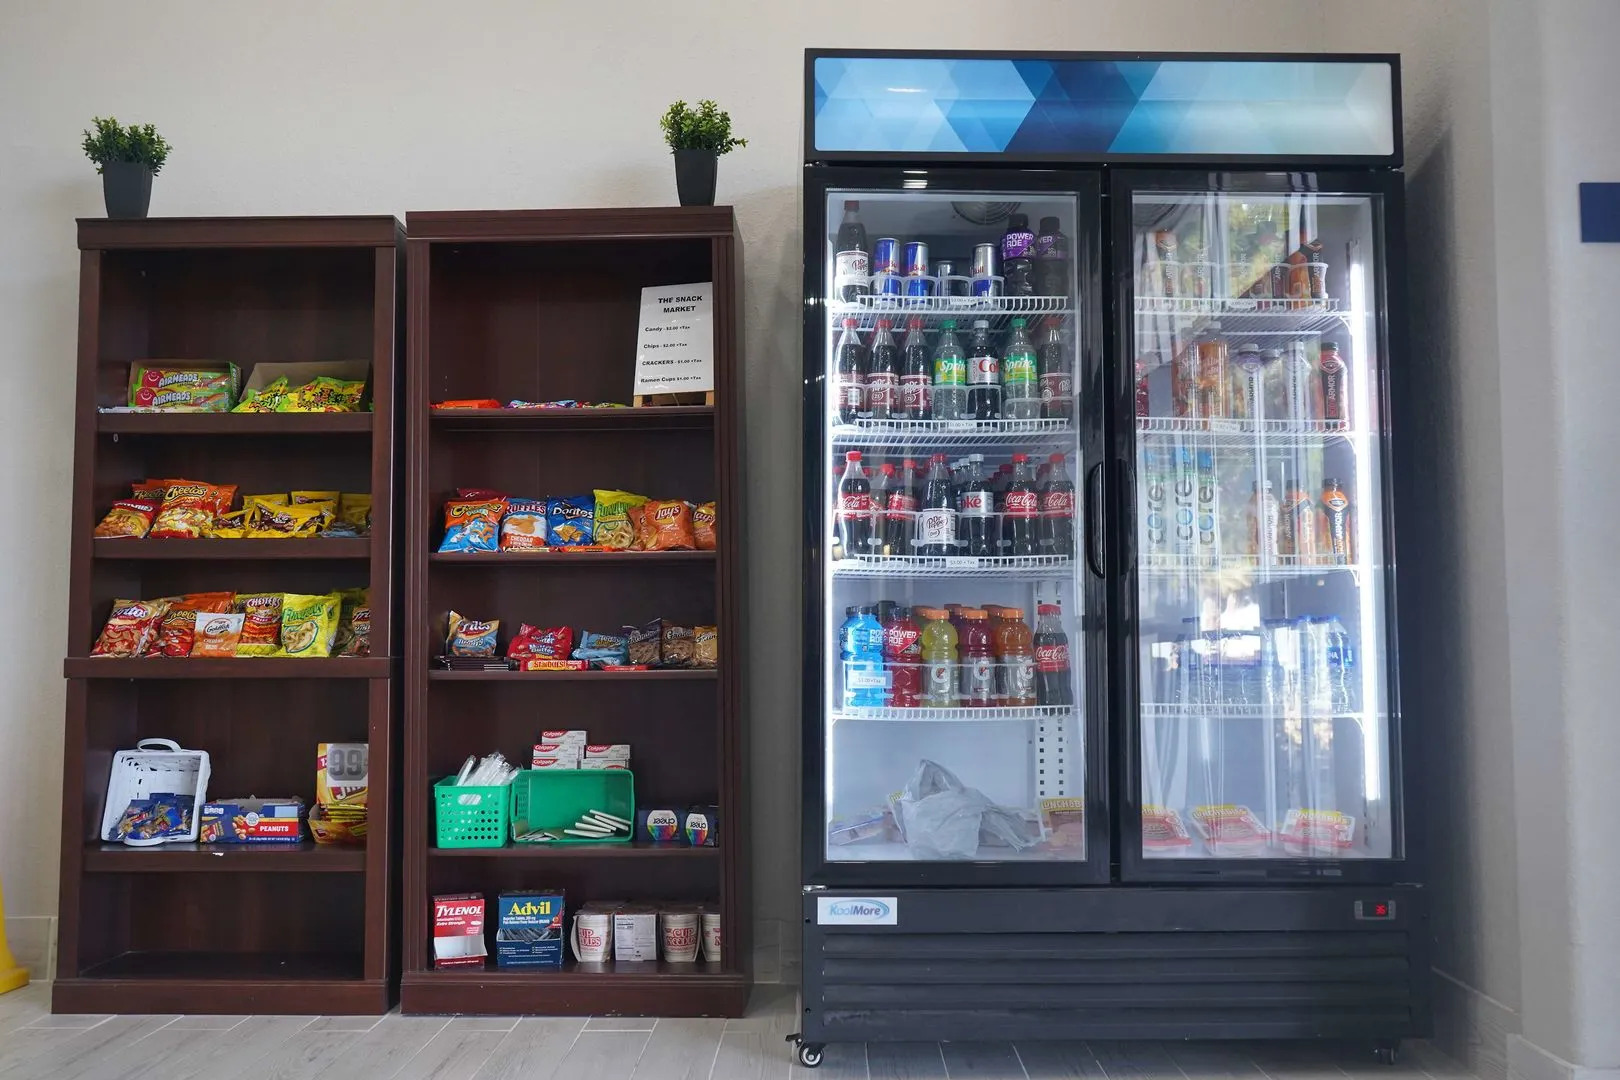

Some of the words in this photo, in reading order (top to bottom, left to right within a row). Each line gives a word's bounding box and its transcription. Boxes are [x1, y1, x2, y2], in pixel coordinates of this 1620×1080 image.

[1006, 232, 1034, 241] POWER
[1006, 240, 1023, 248] ADE
[675, 295, 703, 303] SNACK
[663, 305, 696, 313] MARKET
[941, 360, 966, 372] Sprit
[1004, 360, 1035, 372] Sprite
[158, 373, 199, 388] AIRHEADS
[152, 390, 191, 407] AIRHEADS
[164, 484, 209, 501] Cheetos
[1005, 492, 1038, 507] Coca-Cola
[505, 504, 546, 516] RUFFLES
[553, 506, 595, 519] Doritos
[655, 504, 681, 520] Lay's
[1174, 479, 1193, 540] core
[1198, 485, 1215, 545] core
[206, 624, 230, 633] Goldfish
[888, 629, 917, 639] POWER
[888, 637, 903, 645] ADE
[543, 731, 564, 739] Colgate
[533, 759, 554, 767] Colgate
[436, 905, 482, 917] TYLENOL
[508, 901, 551, 916] Advil
[829, 904, 881, 916] KoolMore
[672, 928, 694, 938] CUP
